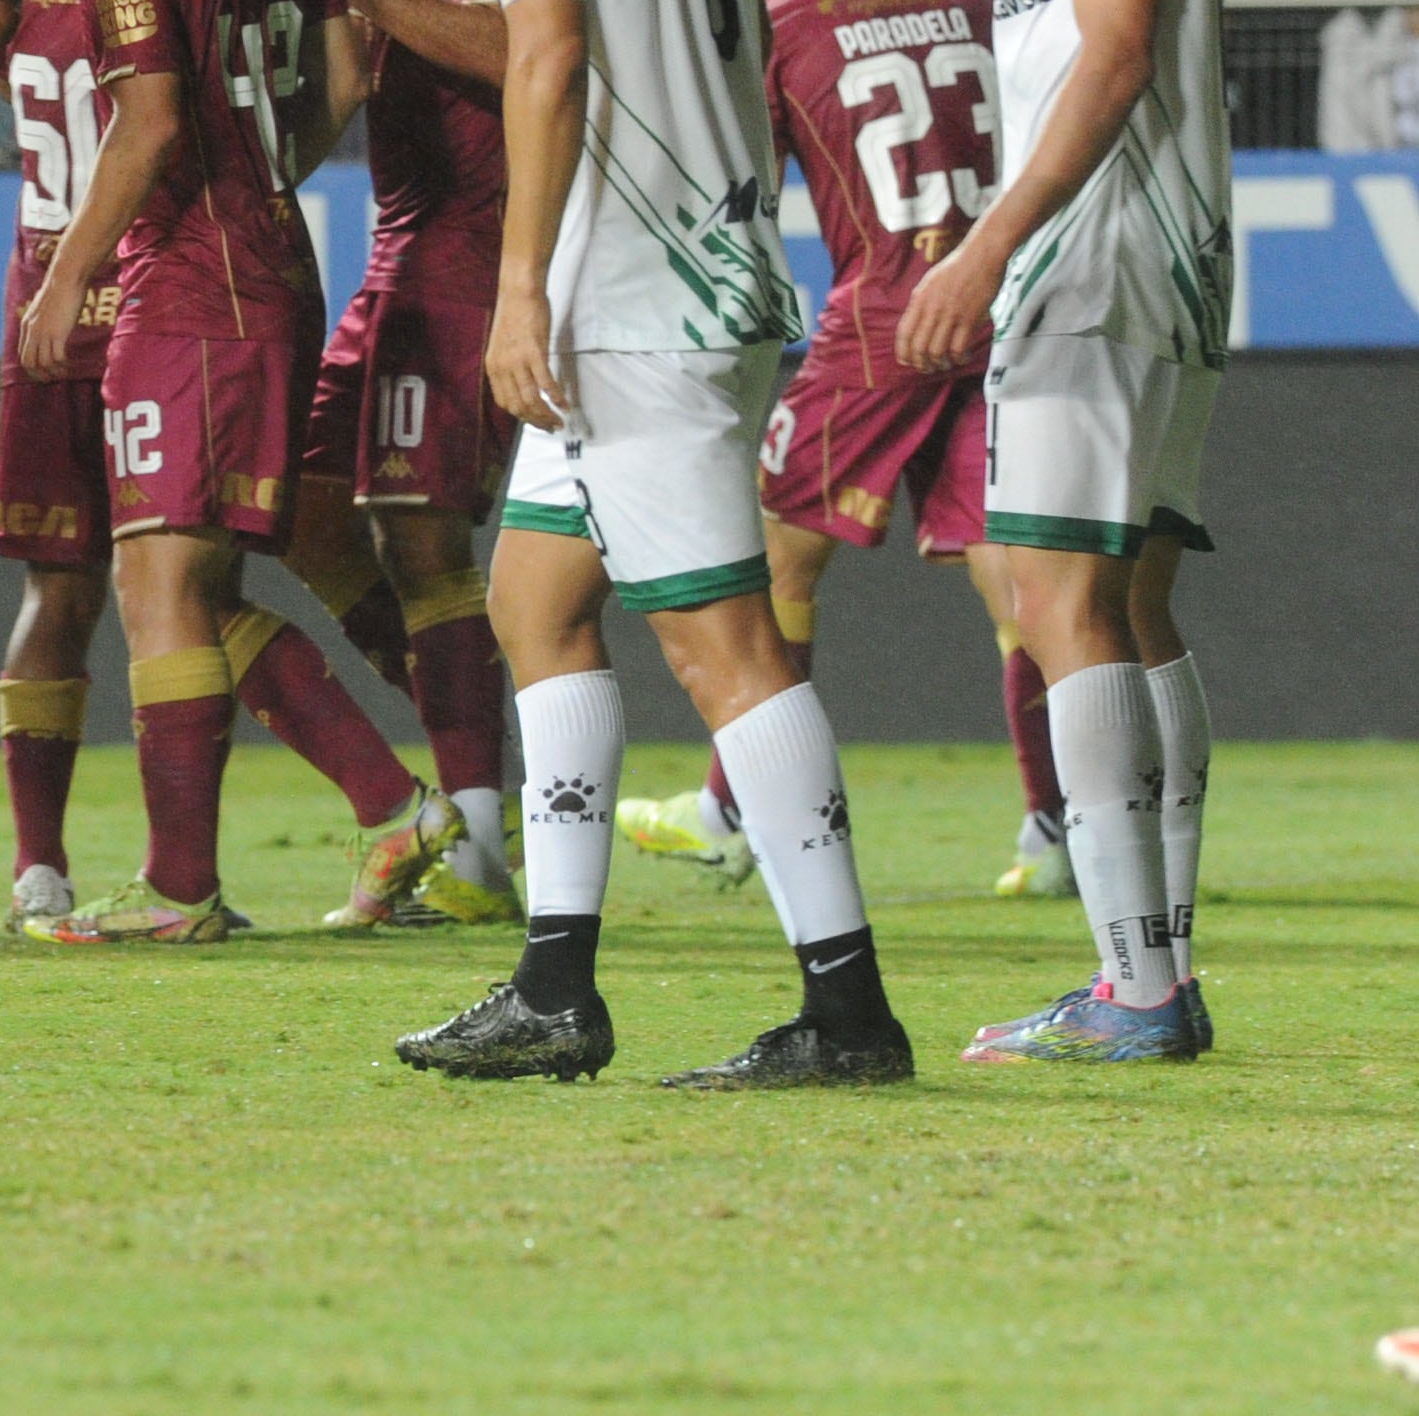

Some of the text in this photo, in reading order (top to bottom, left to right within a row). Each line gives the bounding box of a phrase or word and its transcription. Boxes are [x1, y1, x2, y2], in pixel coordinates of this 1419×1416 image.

[833, 6, 974, 61] PARADELA
[836, 41, 1004, 233] 23
[103, 399, 163, 479] 42
[376, 373, 428, 449] 10
[759, 401, 796, 476] 3
[530, 811, 609, 825] KELME
[801, 830, 851, 852] KEL
